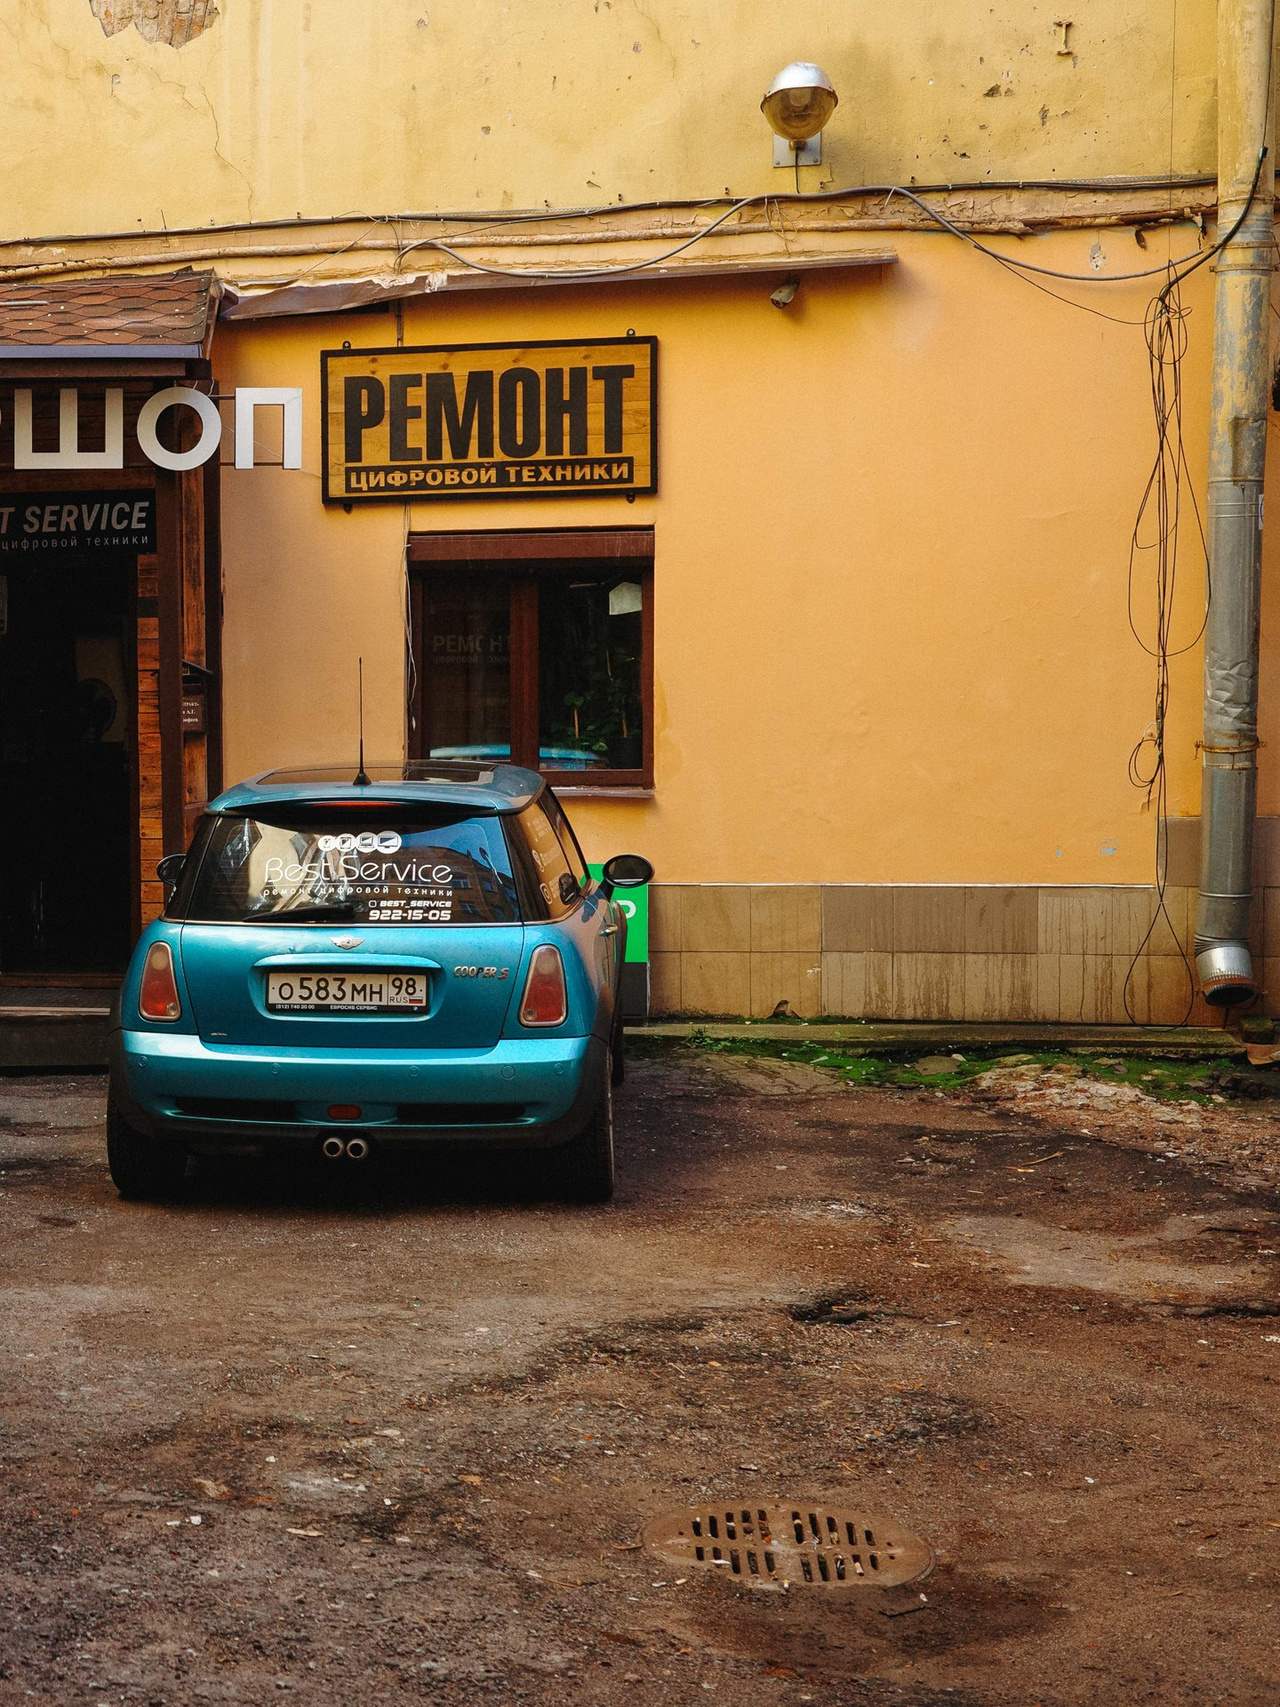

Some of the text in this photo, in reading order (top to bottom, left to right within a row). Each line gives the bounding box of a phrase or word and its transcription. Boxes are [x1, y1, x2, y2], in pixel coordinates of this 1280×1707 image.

[344, 364, 635, 463] РЕМОНТ
[350, 462, 630, 491] ЦИФРОВОЙ ТЕХНИКИ
[23, 501, 150, 534] SERVICE
[1, 536, 78, 551] цифровой
[86, 536, 149, 547] техники
[433, 635, 509, 653] РЕМН
[264, 855, 454, 884] Best Service
[263, 885, 453, 897] ремонт цифровой техники
[380, 900, 453, 909] BEST_SERVICE
[368, 909, 452, 921] 922-15-05
[453, 965, 510, 980] COOPER S
[389, 996, 409, 1004] RUS
